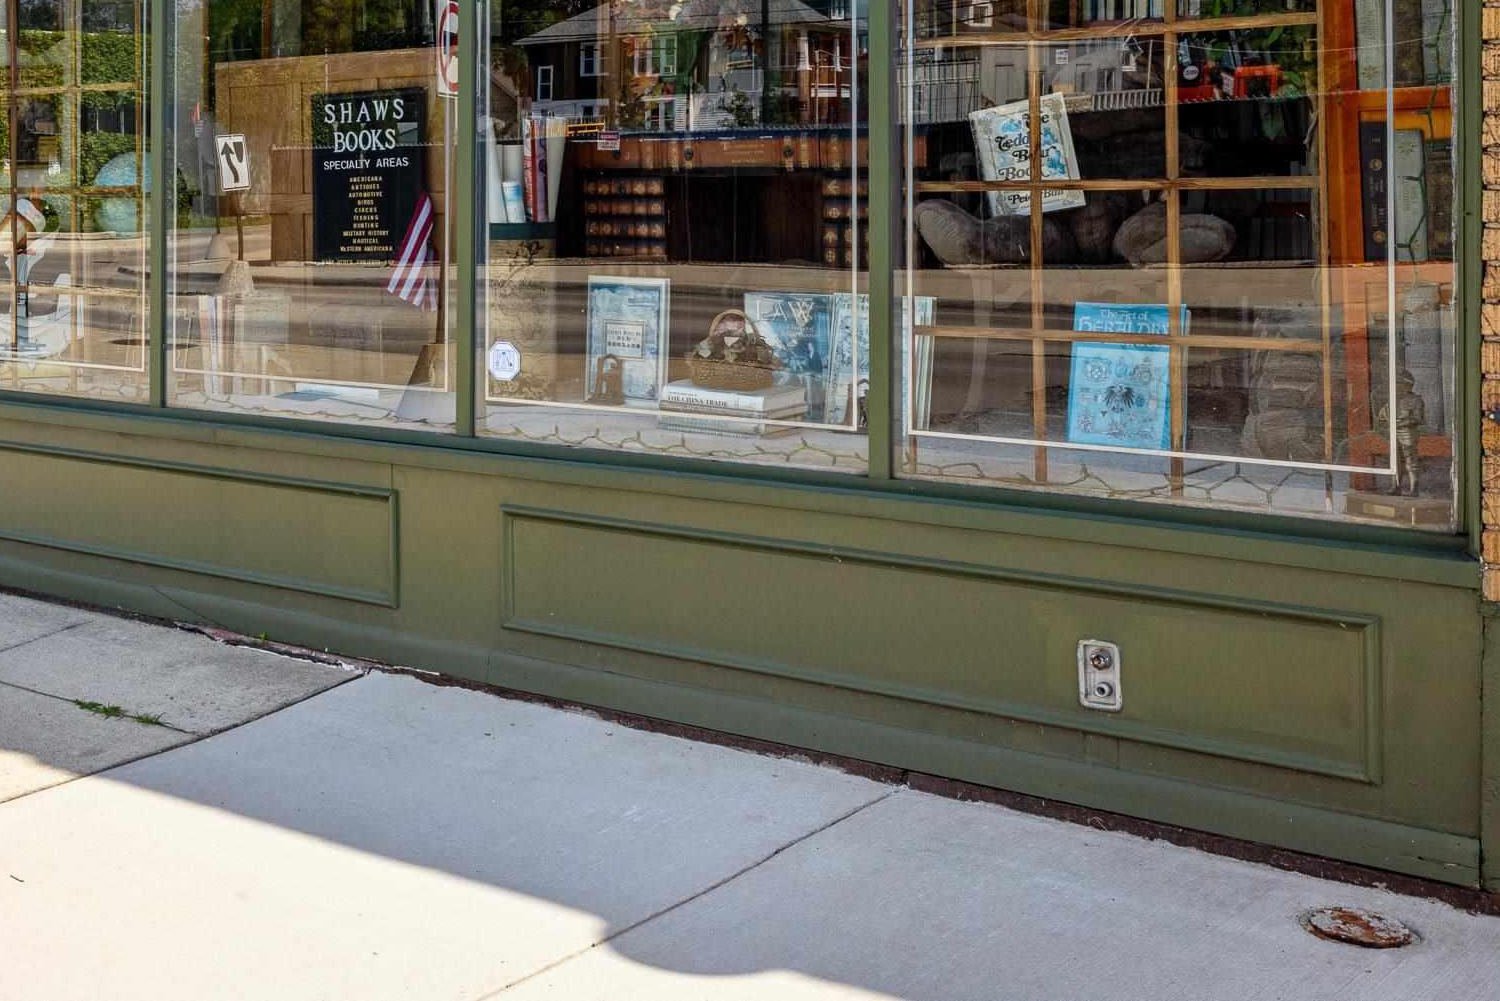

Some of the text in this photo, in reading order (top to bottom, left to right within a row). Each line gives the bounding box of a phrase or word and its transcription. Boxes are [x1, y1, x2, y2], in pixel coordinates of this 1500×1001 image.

[324, 98, 405, 125] SHAWS
[333, 128, 397, 154] BOOKS
[323, 156, 409, 171] SPECIALTY AREAS
